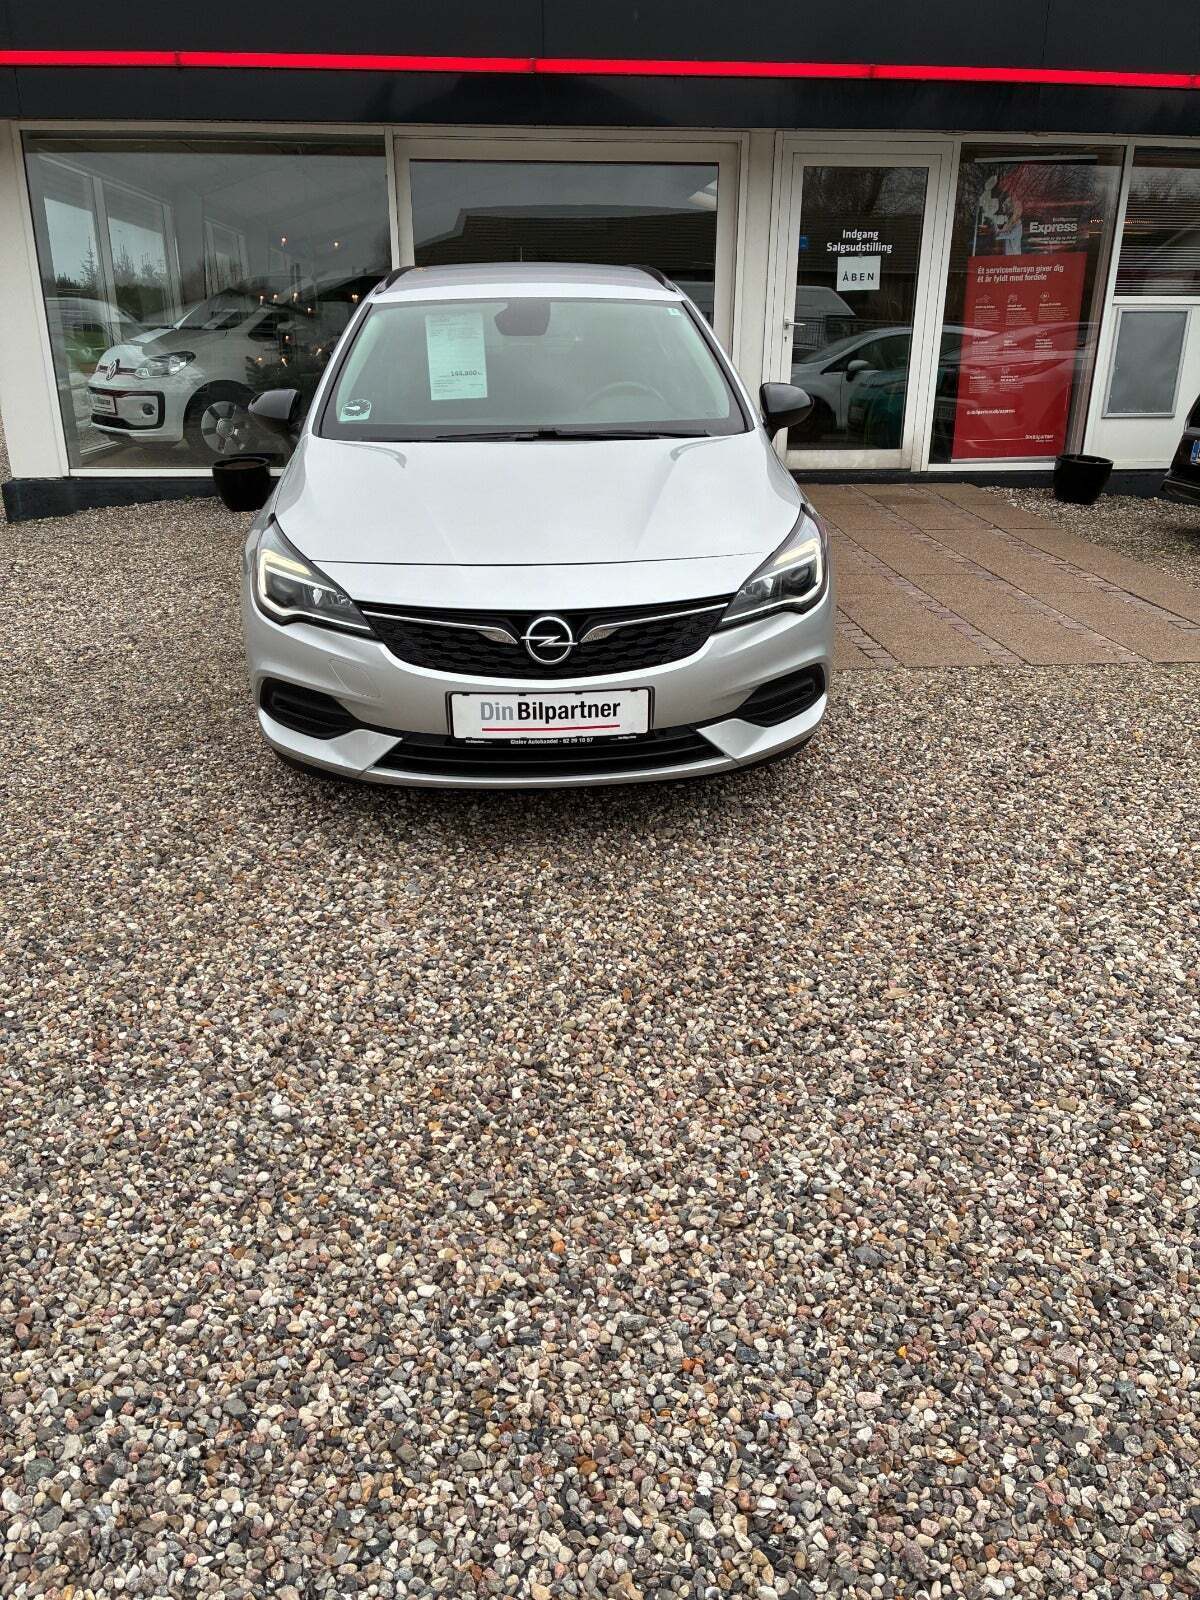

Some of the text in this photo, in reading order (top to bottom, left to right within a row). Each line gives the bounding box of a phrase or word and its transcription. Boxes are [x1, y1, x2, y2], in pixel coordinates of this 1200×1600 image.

[1029, 221, 1078, 235] Express
[842, 229, 880, 240] Indgang
[826, 242, 893, 254] Salgsudstilling
[1053, 263, 1064, 273] dig
[842, 270, 875, 282] ÅBEN
[480, 700, 621, 724] Din Bilpartner
